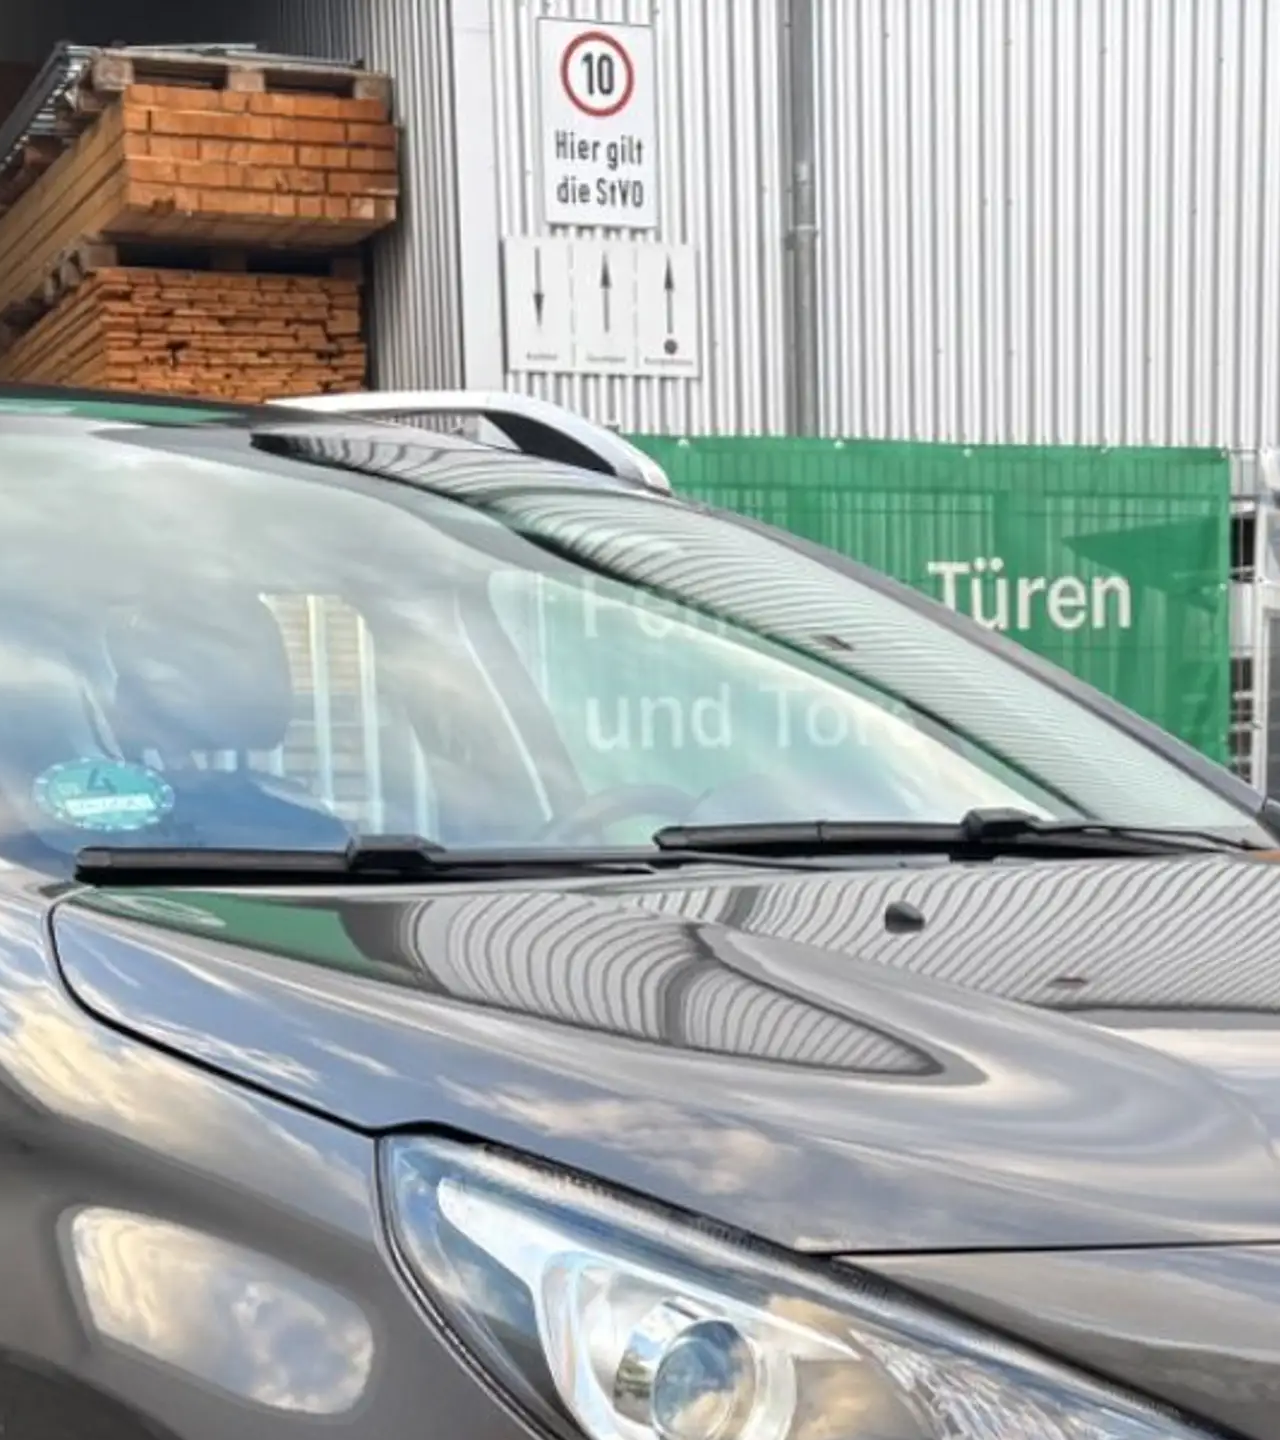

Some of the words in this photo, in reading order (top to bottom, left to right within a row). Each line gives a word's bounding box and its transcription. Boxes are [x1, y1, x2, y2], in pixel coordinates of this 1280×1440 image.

[581, 51, 616, 96] 10
[554, 130, 601, 163] Hier
[607, 134, 644, 171] gilt
[556, 176, 591, 205] die
[596, 178, 644, 208] StVO
[927, 557, 1132, 630] Türen
[585, 682, 733, 750] und
